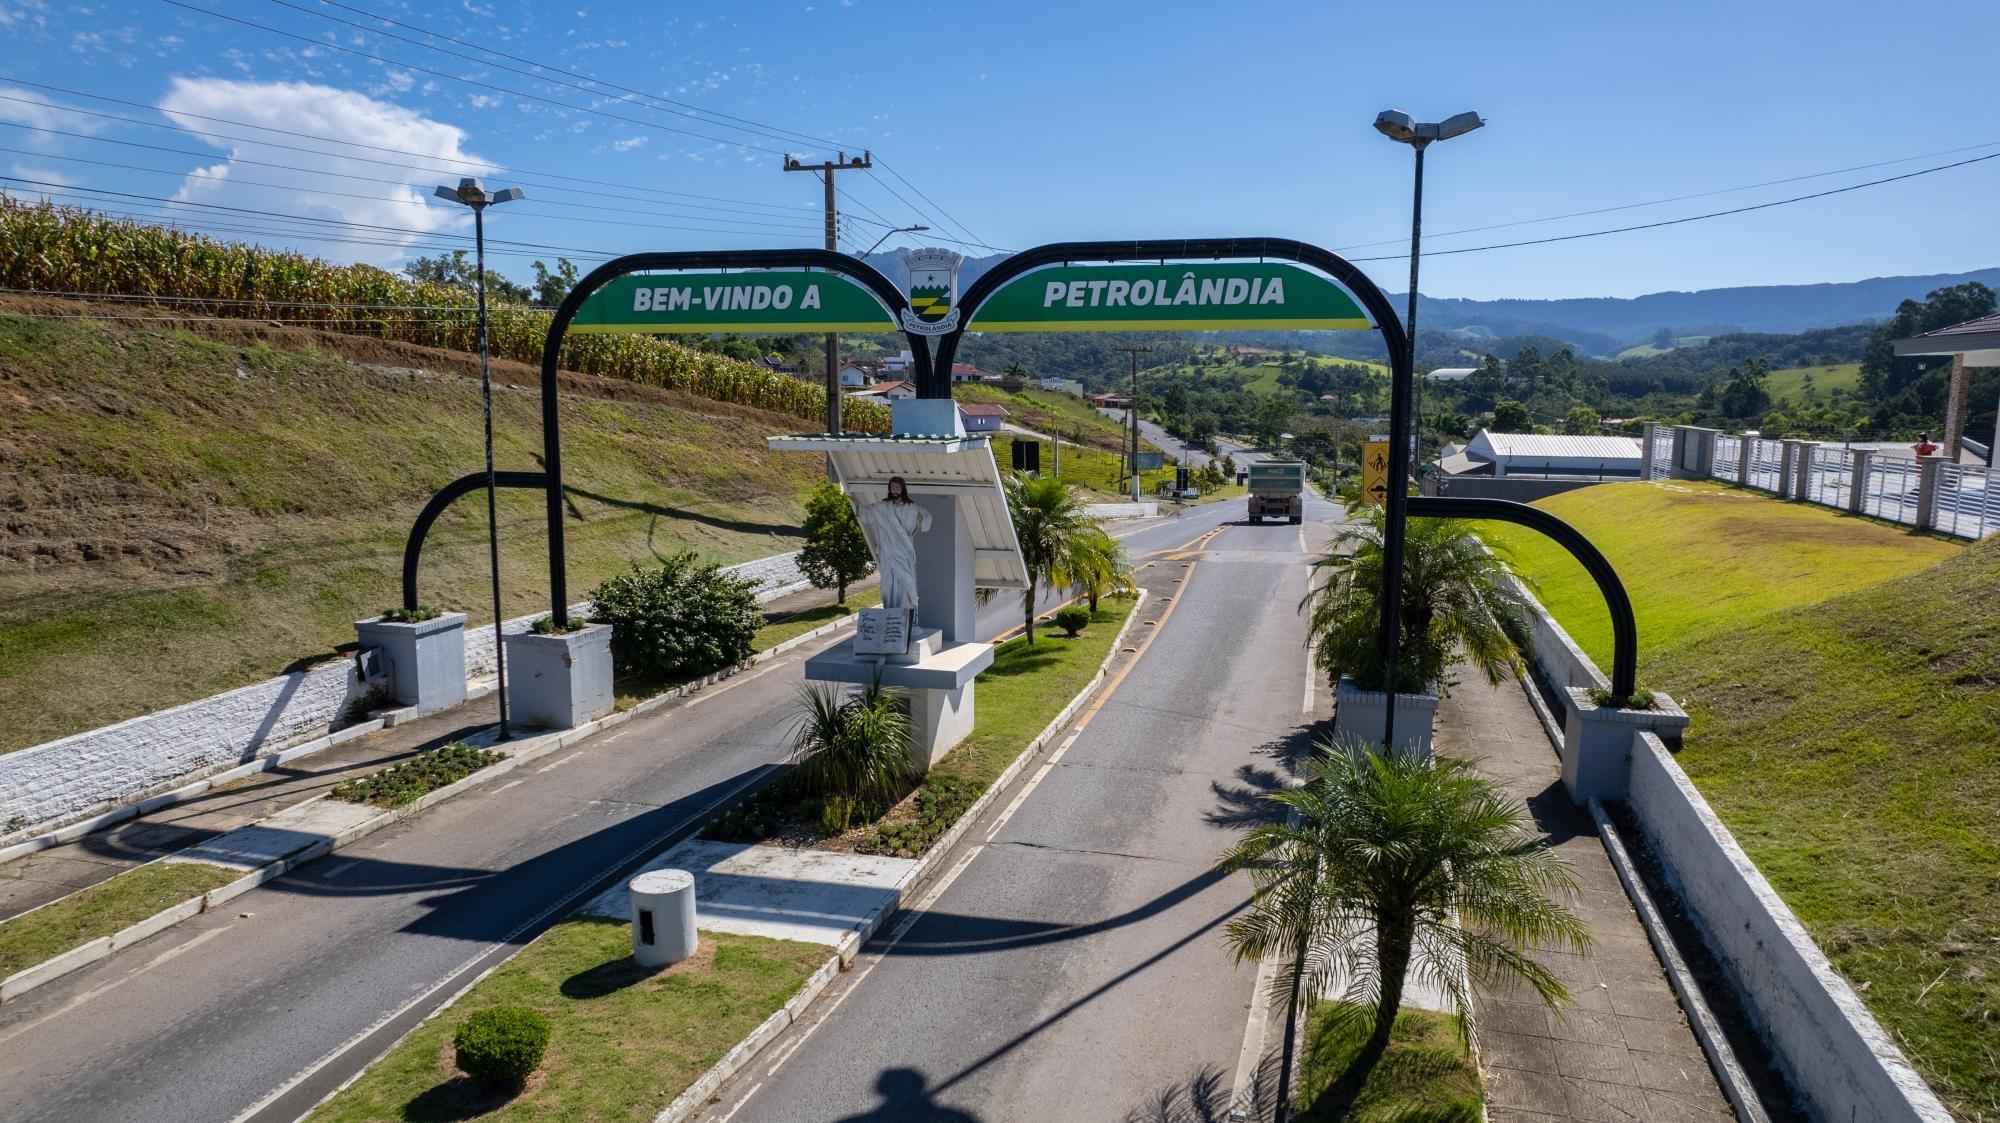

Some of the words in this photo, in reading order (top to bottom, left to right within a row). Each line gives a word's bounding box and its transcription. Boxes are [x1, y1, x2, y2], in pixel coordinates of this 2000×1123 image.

[633, 285, 793, 311] BEM-VINDO
[800, 285, 821, 309] A
[1044, 272, 1285, 307] PETROLÂNDIA
